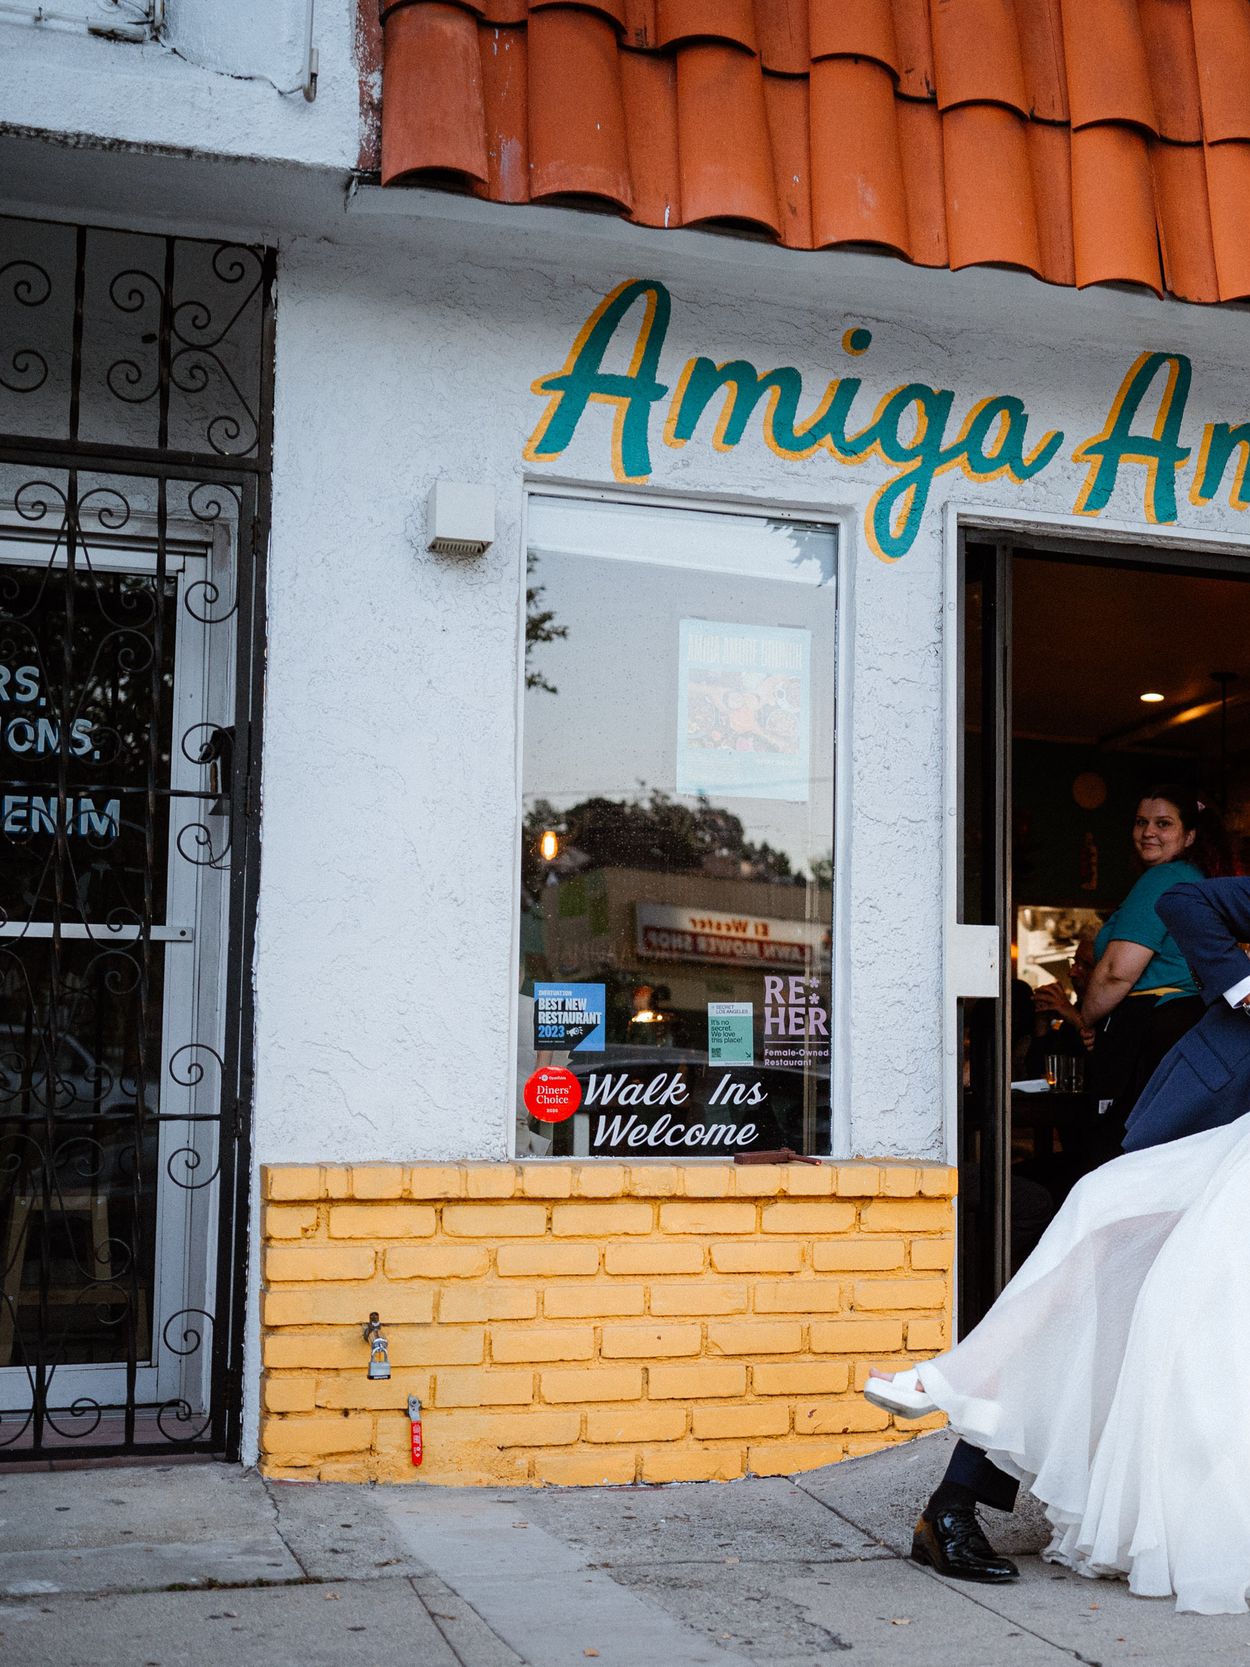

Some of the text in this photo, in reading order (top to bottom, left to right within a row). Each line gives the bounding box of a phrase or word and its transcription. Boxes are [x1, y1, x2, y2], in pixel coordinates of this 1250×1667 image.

[522, 278, 1064, 564] Amiga
[3, 795, 121, 837] ENIM
[538, 997, 587, 1011] BEST NEW
[538, 1011, 602, 1024] RESTAURANT
[764, 1007, 829, 1036] HER
[538, 1025, 565, 1038] 2023
[764, 1048, 829, 1056] Female-Owned
[584, 1072, 768, 1105] Walk Ins
[536, 1095, 569, 1104] Choice
[593, 1114, 759, 1147] Welcome
